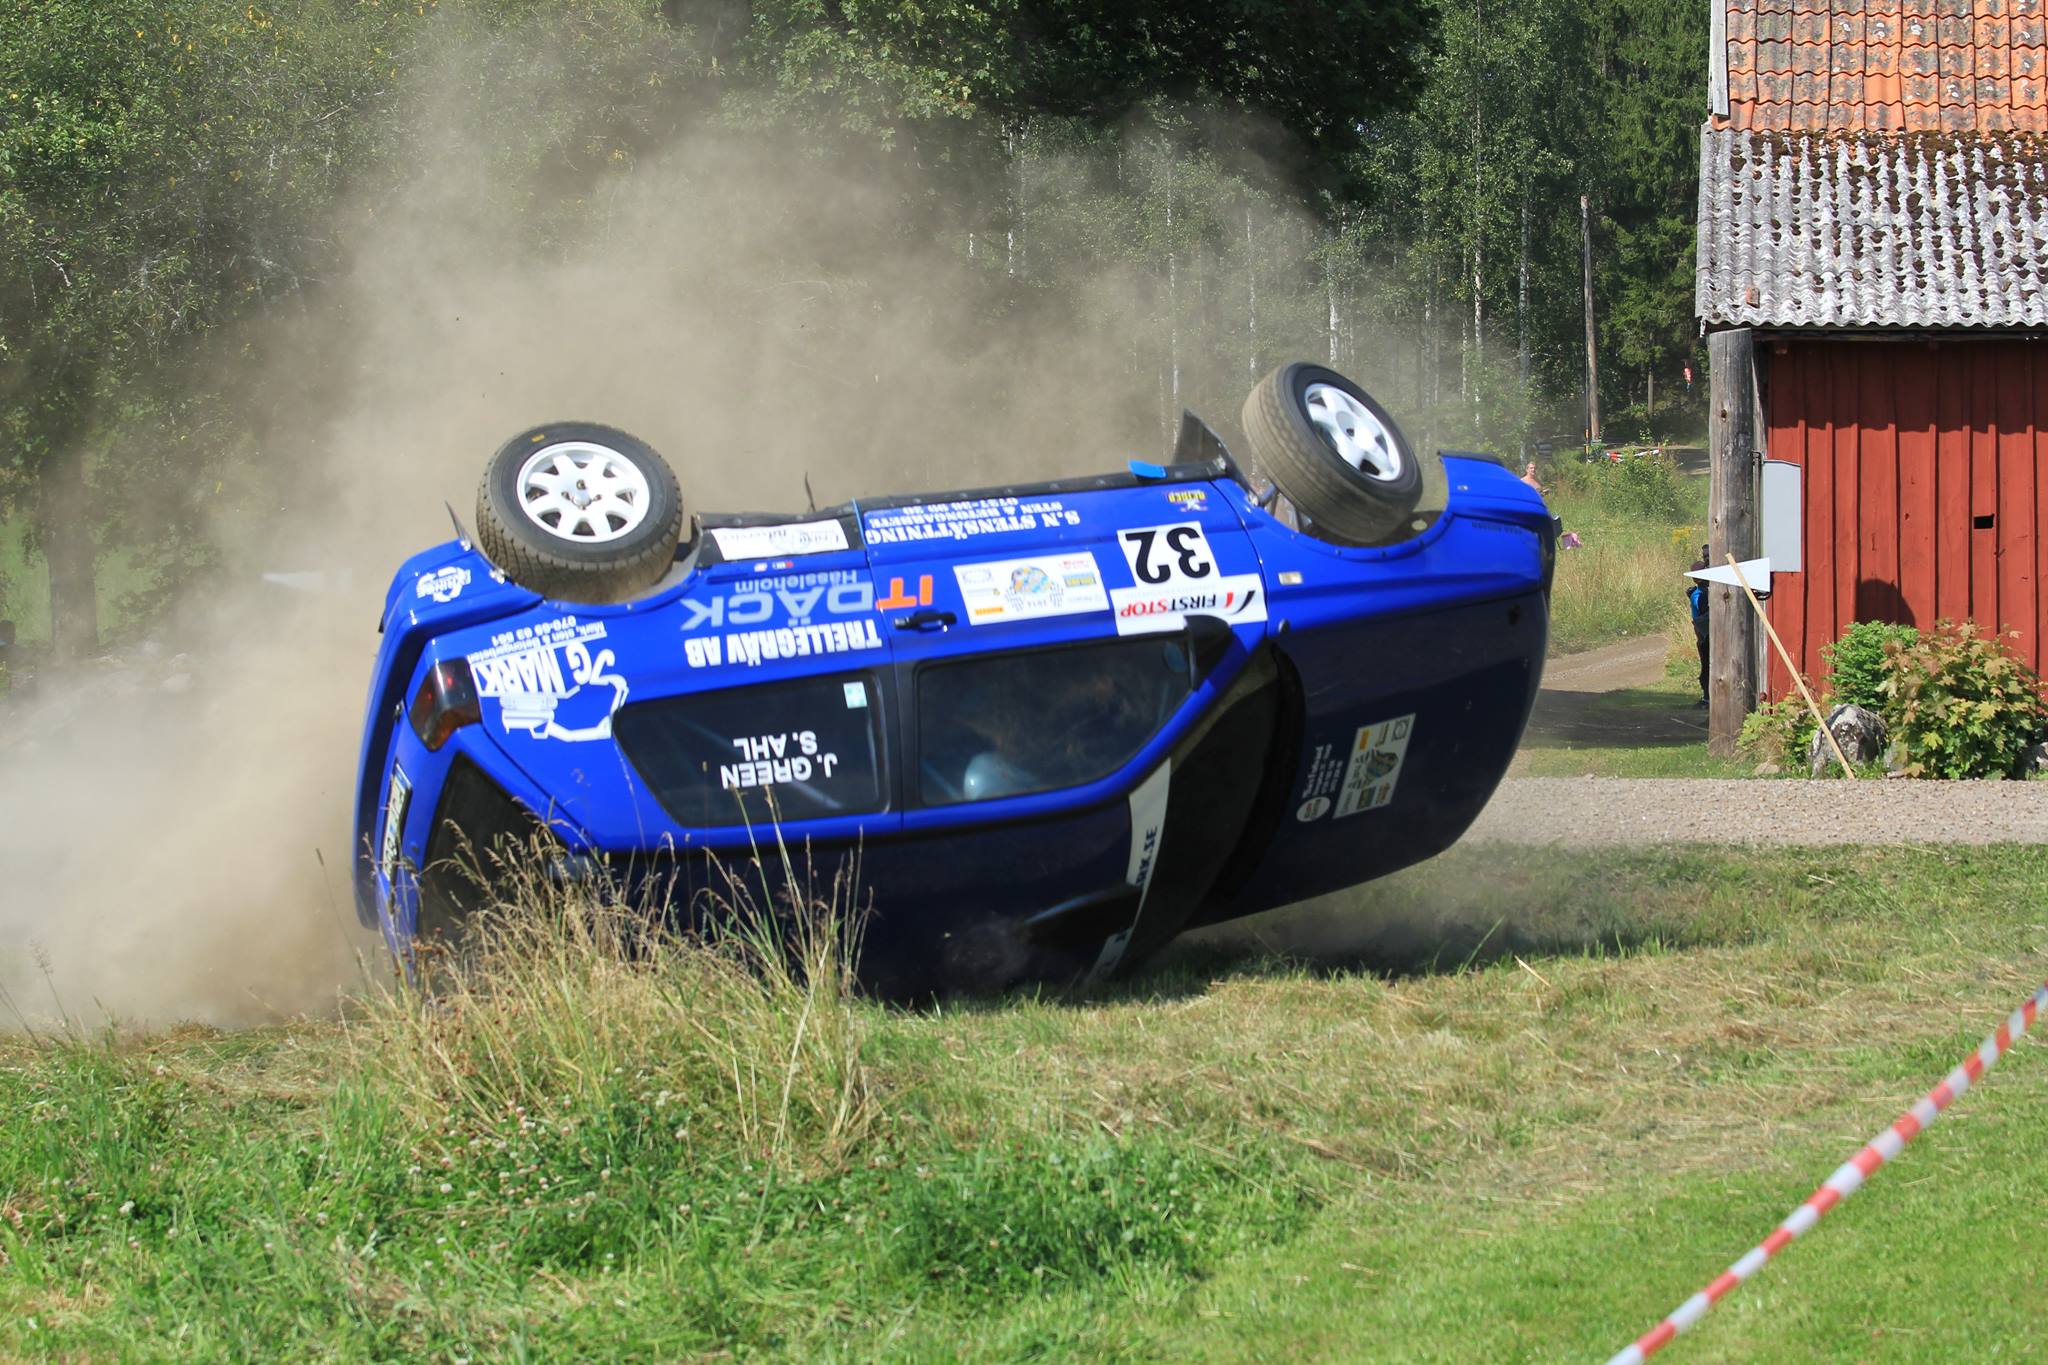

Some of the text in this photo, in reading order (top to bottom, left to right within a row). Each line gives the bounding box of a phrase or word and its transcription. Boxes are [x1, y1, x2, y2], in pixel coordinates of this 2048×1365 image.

[1004, 506, 1017, 516] &
[864, 513, 1037, 545] STENSÄTTNING
[1124, 526, 1211, 584] 32
[735, 570, 858, 594] Hässleholm
[684, 619, 883, 669] TRELLEGRÄV AB
[733, 730, 818, 761] S. AHL
[720, 753, 838, 789] J. GREEN
